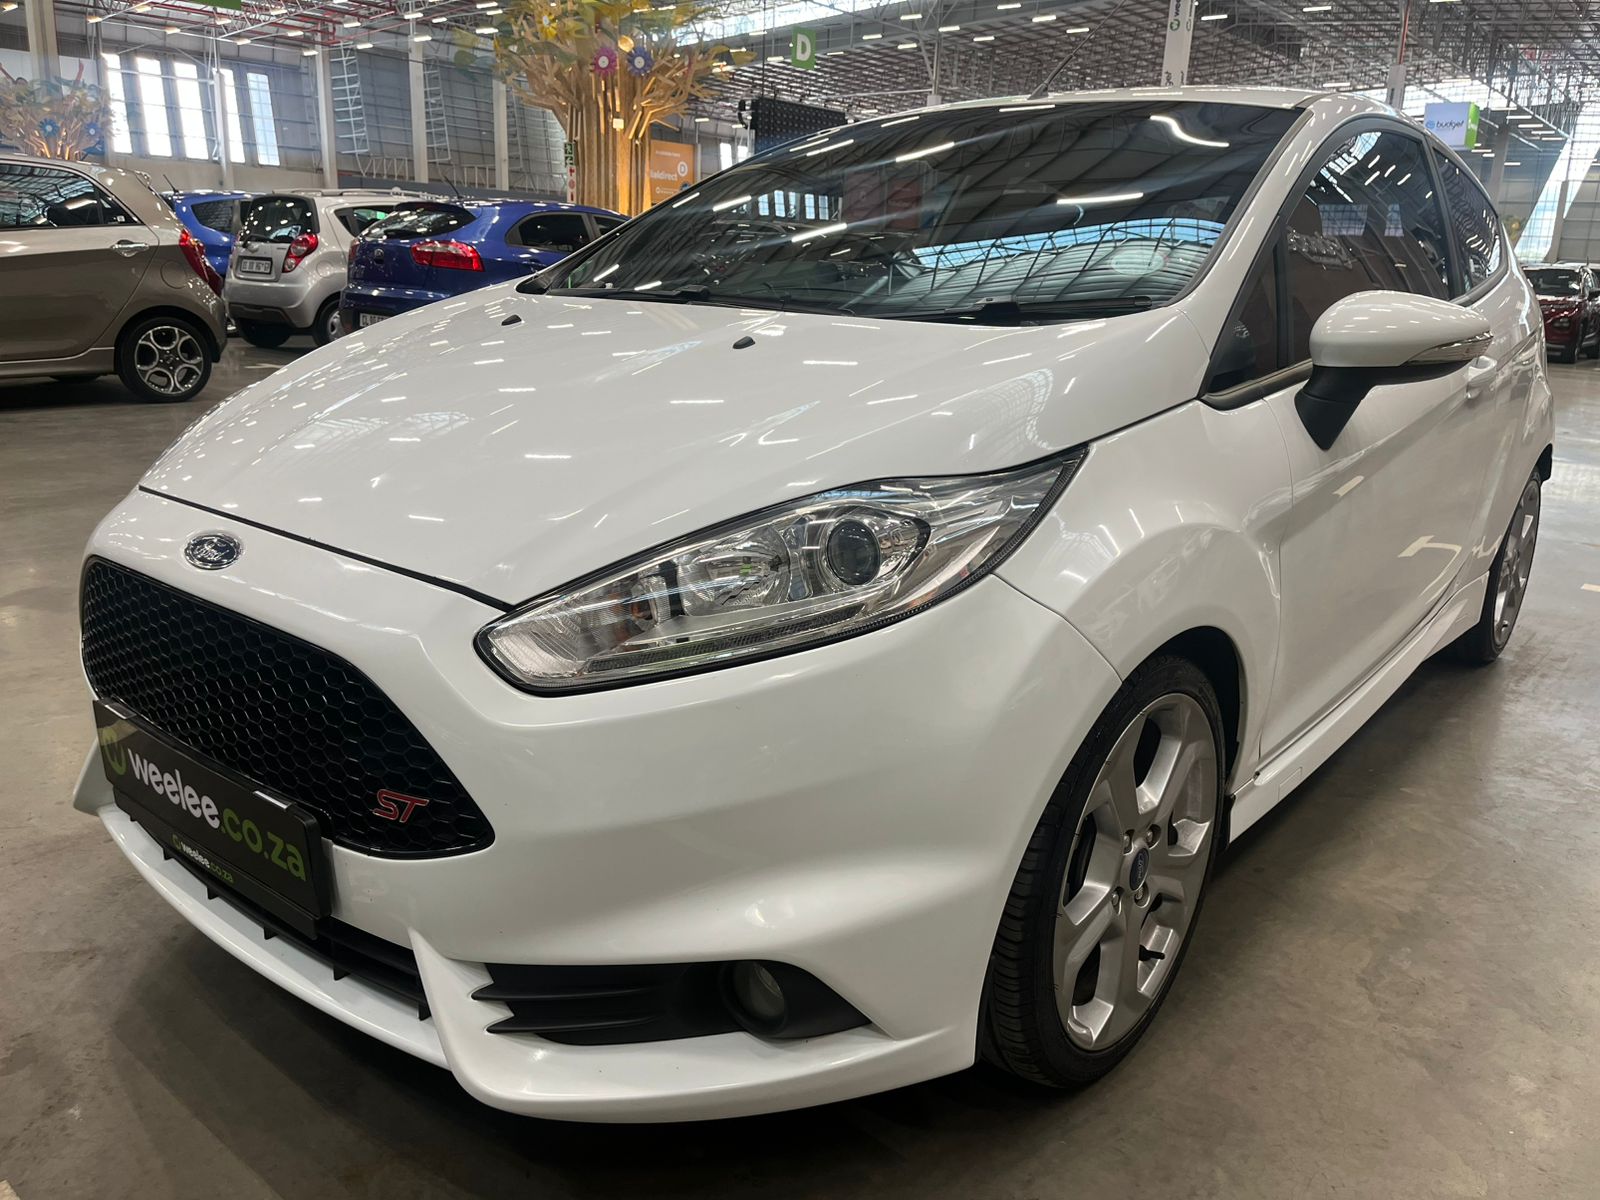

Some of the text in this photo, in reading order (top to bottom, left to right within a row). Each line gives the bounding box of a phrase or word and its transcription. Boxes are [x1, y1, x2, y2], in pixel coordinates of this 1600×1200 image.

[796, 33, 811, 61] D
[1436, 120, 1464, 130] budget
[192, 540, 230, 561] Ford
[128, 748, 306, 881] weelee.co.za
[372, 788, 430, 823] ST
[180, 841, 234, 884] weelee.co.za
